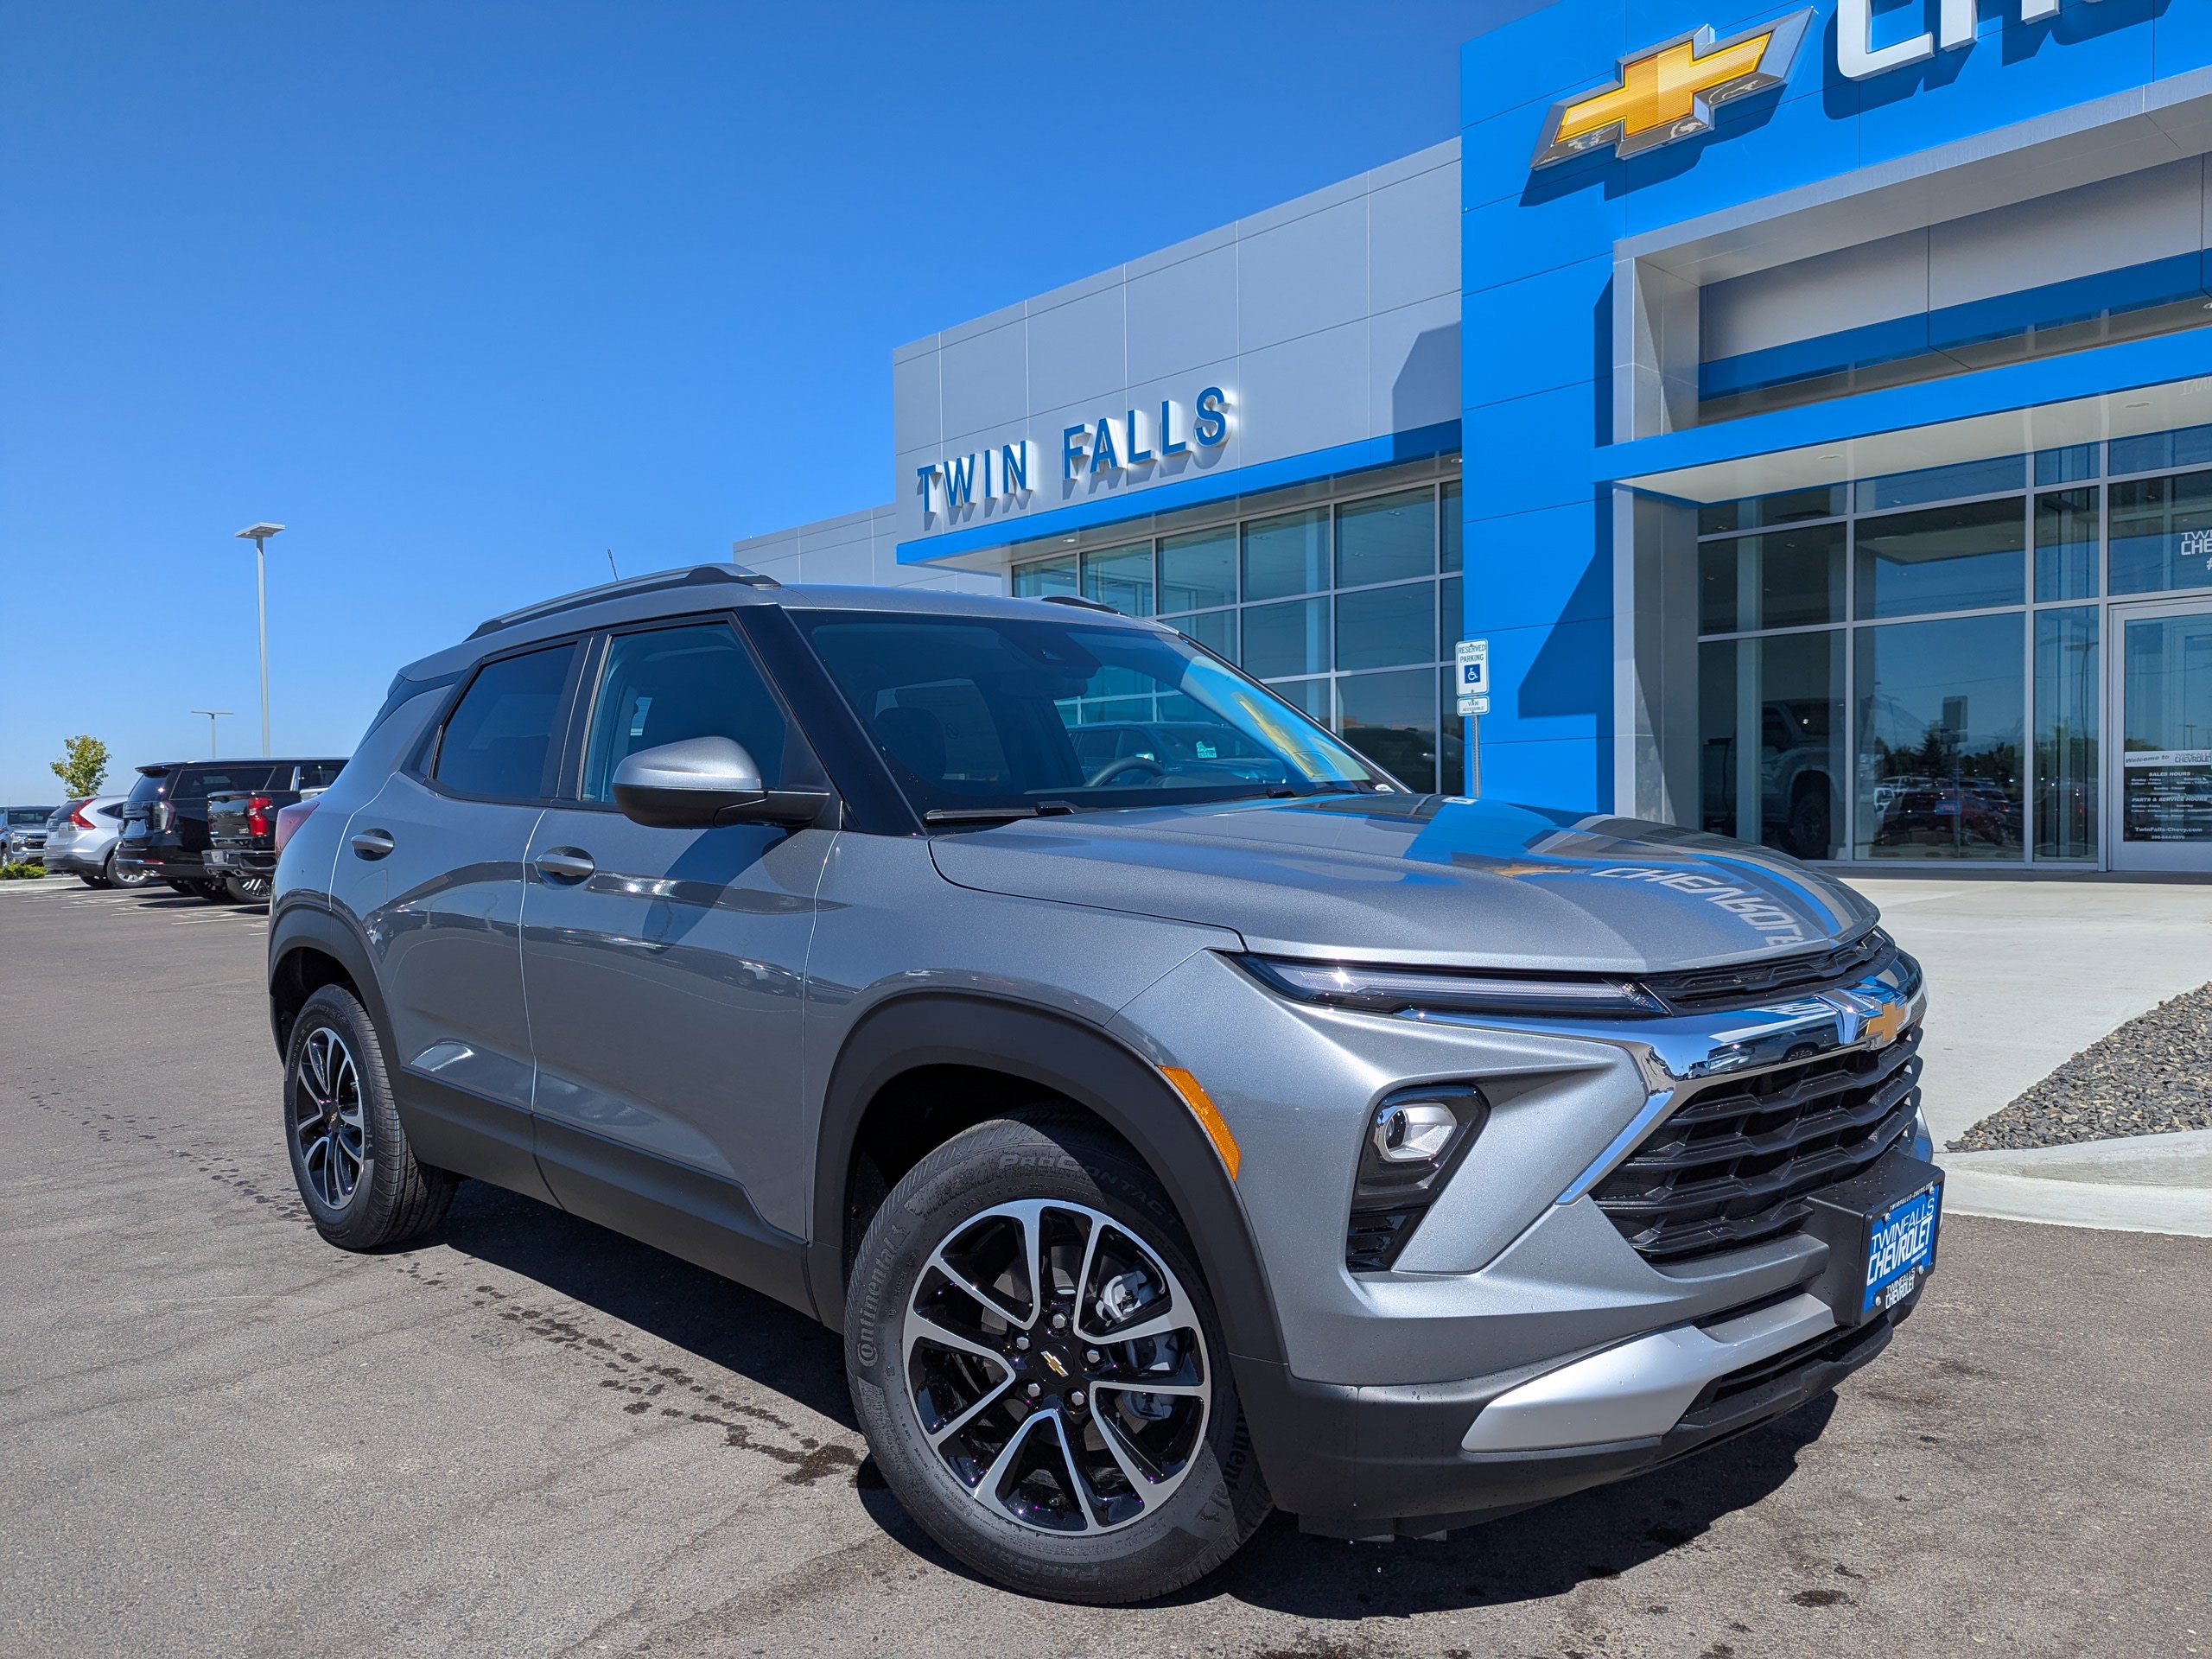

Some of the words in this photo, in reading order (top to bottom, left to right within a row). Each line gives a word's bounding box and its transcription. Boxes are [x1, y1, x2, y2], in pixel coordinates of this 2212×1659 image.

[917, 439, 1033, 512] TWIN
[1063, 386, 1232, 480] FALLS
[1458, 644, 1485, 654] RESERVED
[1459, 654, 1484, 664] PARKING
[1872, 1197, 1935, 1254] TWINFALLS
[1866, 1215, 1934, 1287] CHEVROLET
[857, 1236, 900, 1368] Continental
[1885, 1275, 1916, 1310] CHEVROLET
[1886, 1267, 1916, 1294] TWINFALLS
